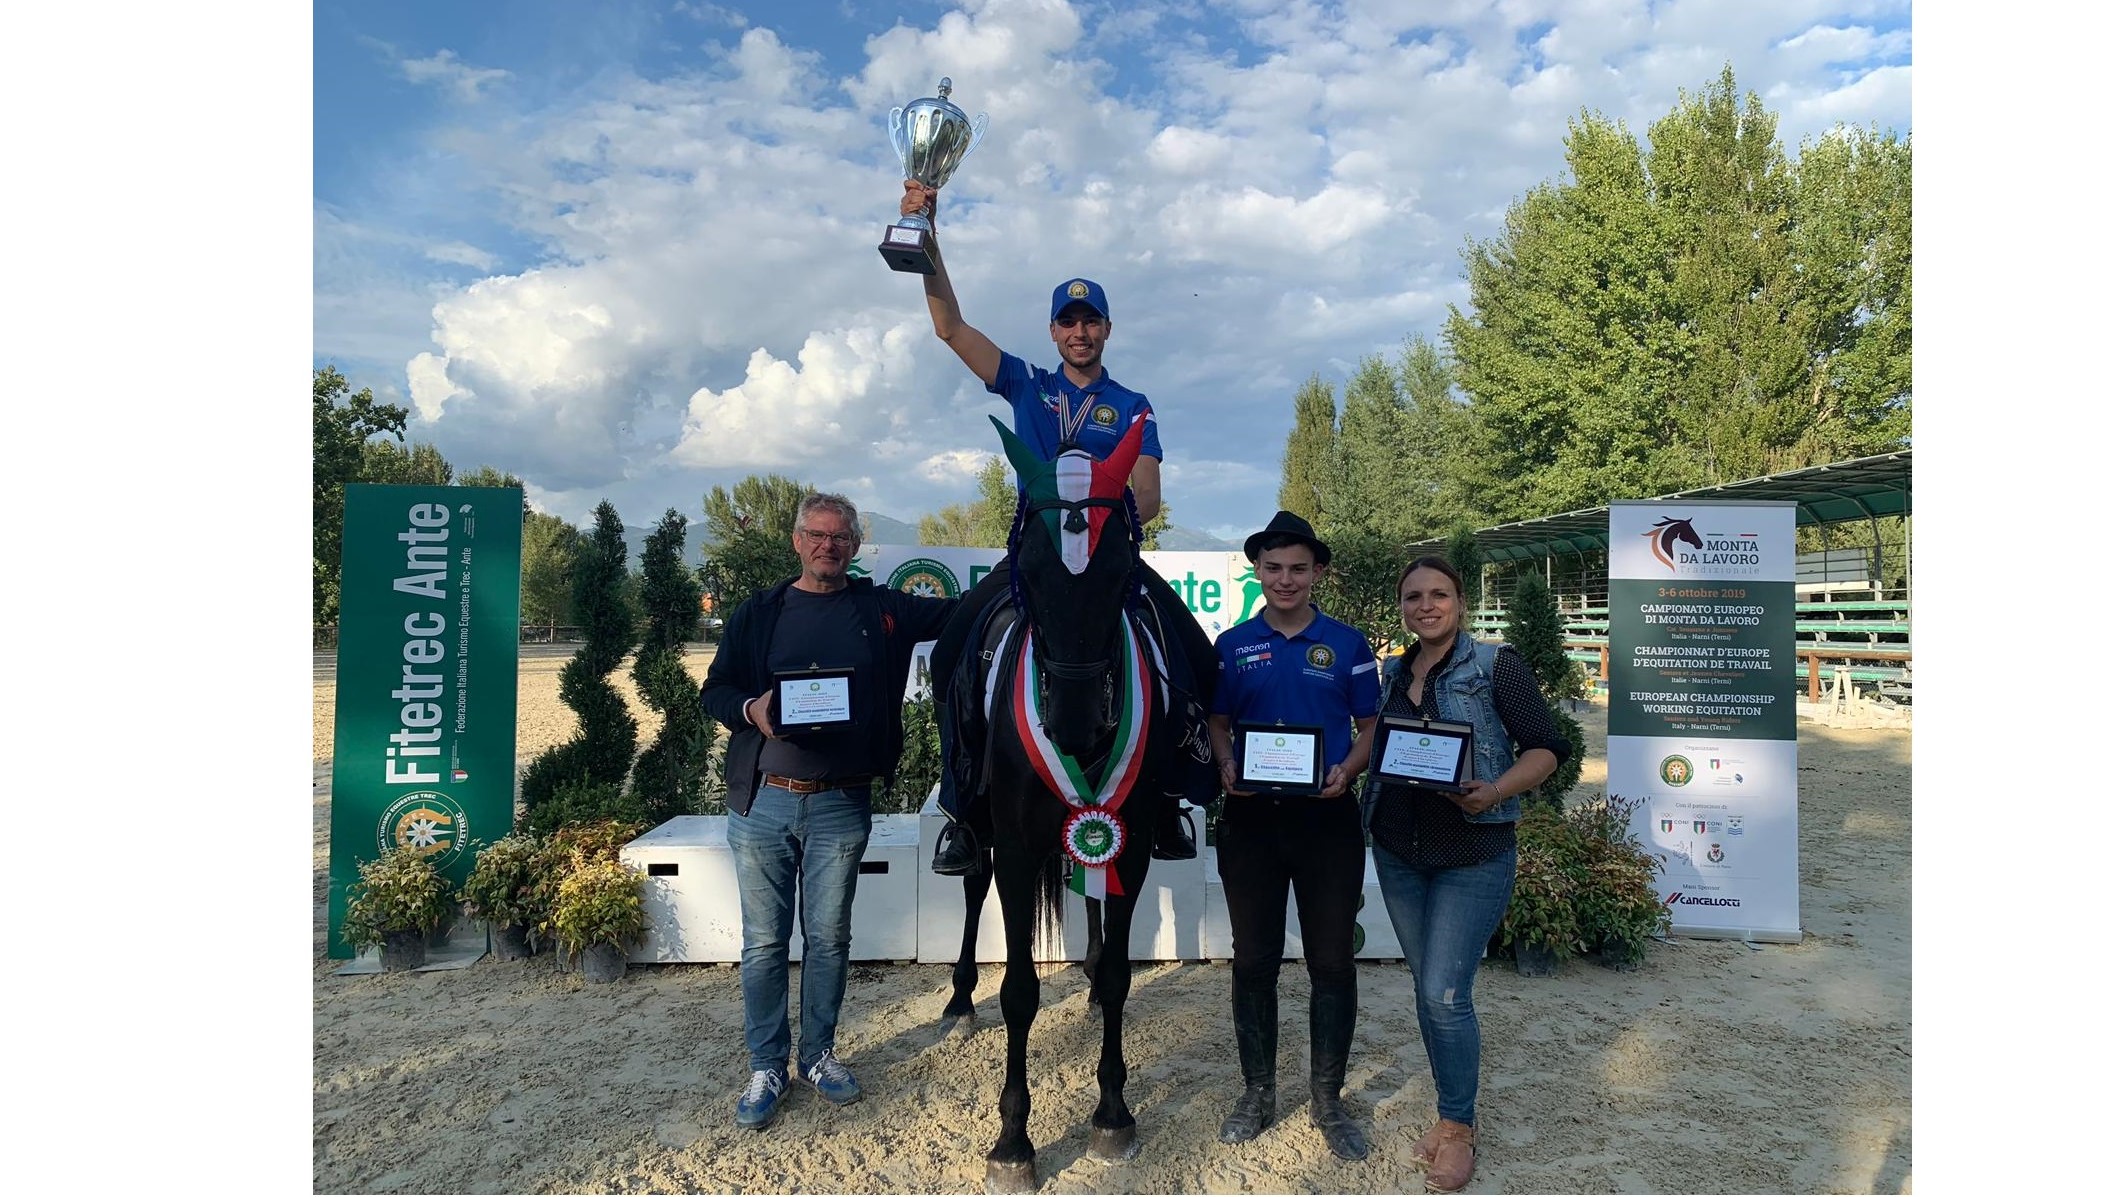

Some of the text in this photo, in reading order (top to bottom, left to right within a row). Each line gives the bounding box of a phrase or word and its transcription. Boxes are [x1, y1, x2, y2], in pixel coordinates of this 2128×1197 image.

[1707, 540, 1759, 551] MONTA
[461, 547, 472, 565] Ante
[1679, 553, 1760, 565] DA LAVORO
[1680, 565, 1760, 576] Tradizionale
[460, 572, 471, 587] Trec
[1658, 587, 1746, 599] 3-6 ottobre 2019
[459, 594, 471, 627] Equestre
[1640, 604, 1764, 615] CAMPIONATO EUROPEO
[1645, 615, 1760, 626] DI MONTA DA LAVORO
[385, 503, 450, 784] Fitetrec Ante
[458, 628, 469, 658] Turismo
[1235, 642, 1271, 656] macron
[1634, 646, 1770, 658] CHAMPIONNAT D'EUROPE
[1236, 660, 1273, 674] ITALIA
[1633, 658, 1772, 670] D'EQUITATION DE TRAVAIL
[457, 658, 468, 688] Italiana
[1629, 691, 1776, 704] EUROPEAN CHAMPIONSHIP
[455, 689, 467, 733] Federazione
[1643, 704, 1762, 716] WORKING EQUITATION
[1671, 722, 1686, 730] Italy
[379, 812, 392, 838] TURISMO
[390, 794, 419, 813] EQUESTRE
[454, 811, 467, 852] FITETREC
